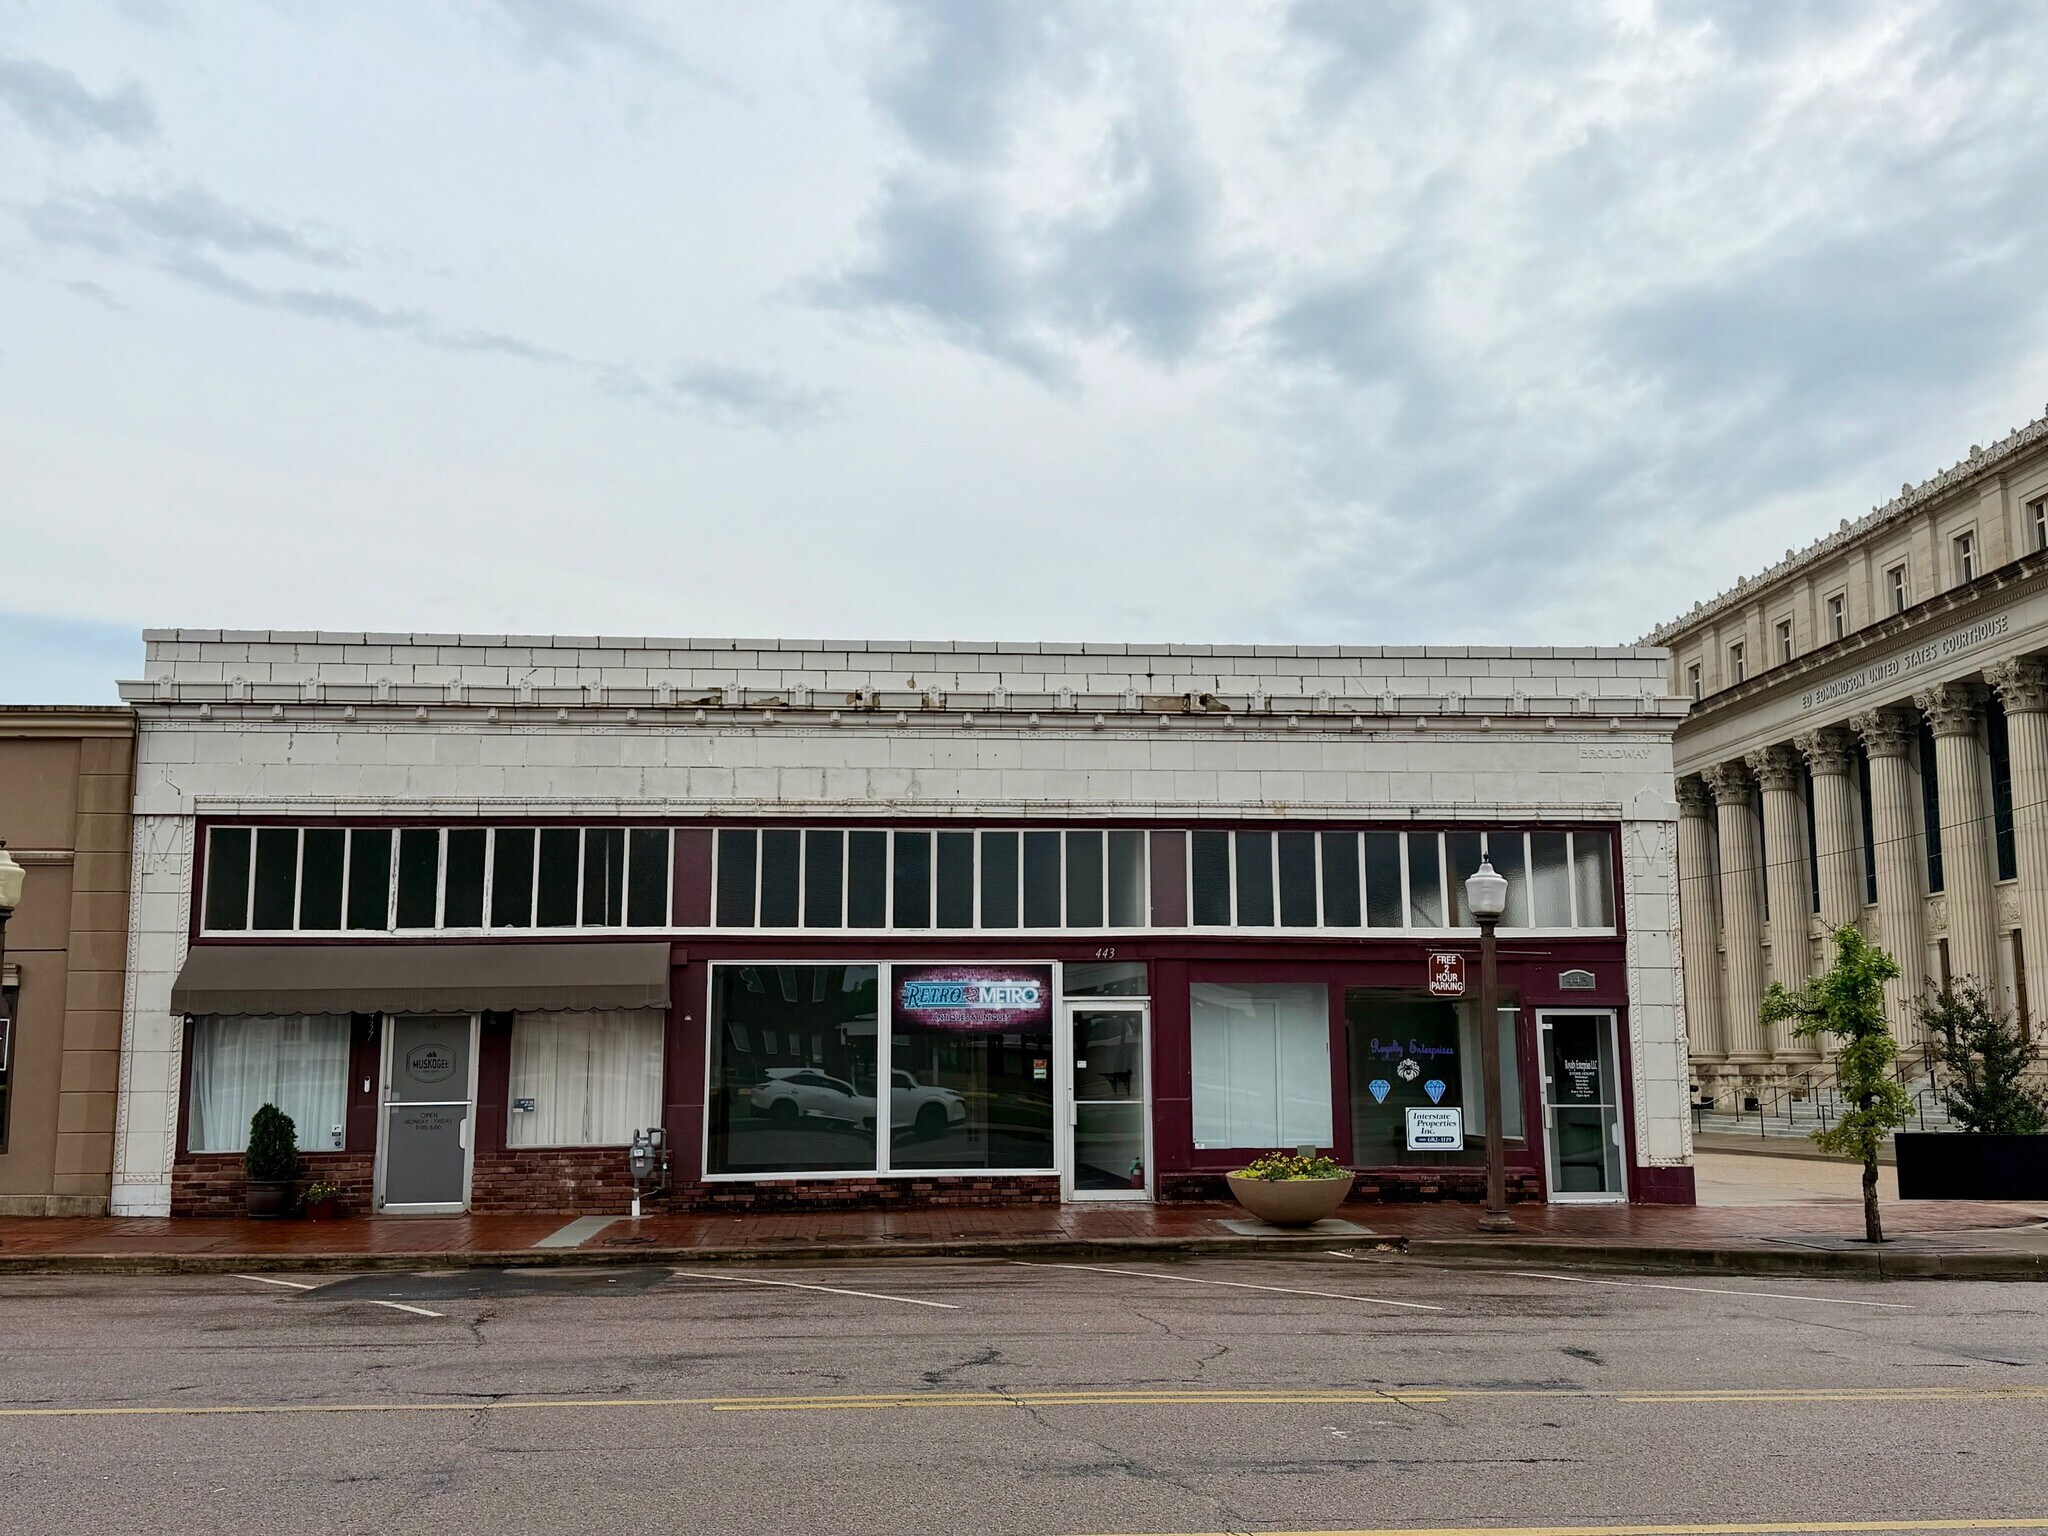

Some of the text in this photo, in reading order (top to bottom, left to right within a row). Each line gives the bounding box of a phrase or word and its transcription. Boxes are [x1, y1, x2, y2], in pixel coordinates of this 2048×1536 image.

[1802, 615, 2009, 709] ED EDMONDSON UNITED STATES COURTHOUSE
[1580, 749, 1651, 760] BROADWAY
[1095, 947, 1116, 959] 443
[1436, 955, 1457, 965] FREE
[1443, 964, 1450, 974] 2
[1436, 973, 1458, 982] HOUR
[1431, 981, 1463, 991] PARKING
[906, 985, 962, 1008] RETRO
[979, 987, 1039, 1004] METRO
[932, 1013, 1011, 1021] ANTIQUES & UNIQUES
[1409, 1038, 1454, 1060] Enterprises
[413, 1058, 449, 1069] MUSKOGEE
[1413, 1112, 1451, 1120] Interstate
[1416, 1120, 1457, 1129] Properties
[1421, 1127, 1435, 1135] Inc.
